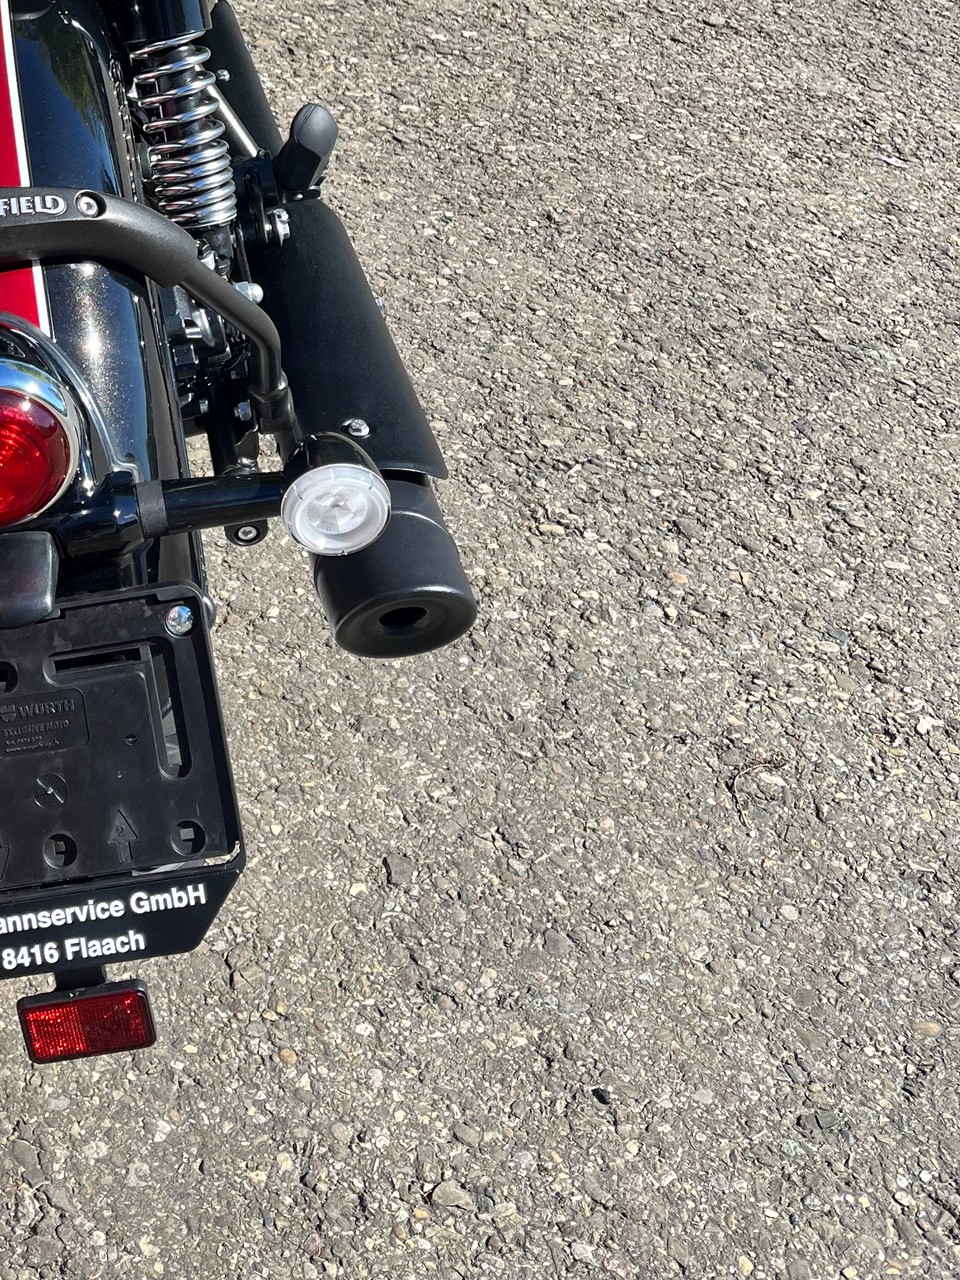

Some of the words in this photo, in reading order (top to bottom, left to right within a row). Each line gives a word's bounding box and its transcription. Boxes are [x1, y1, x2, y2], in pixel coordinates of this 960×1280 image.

[129, 884, 207, 915] GmbH
[1, 946, 59, 970] 8416
[65, 930, 146, 959] Flaach
